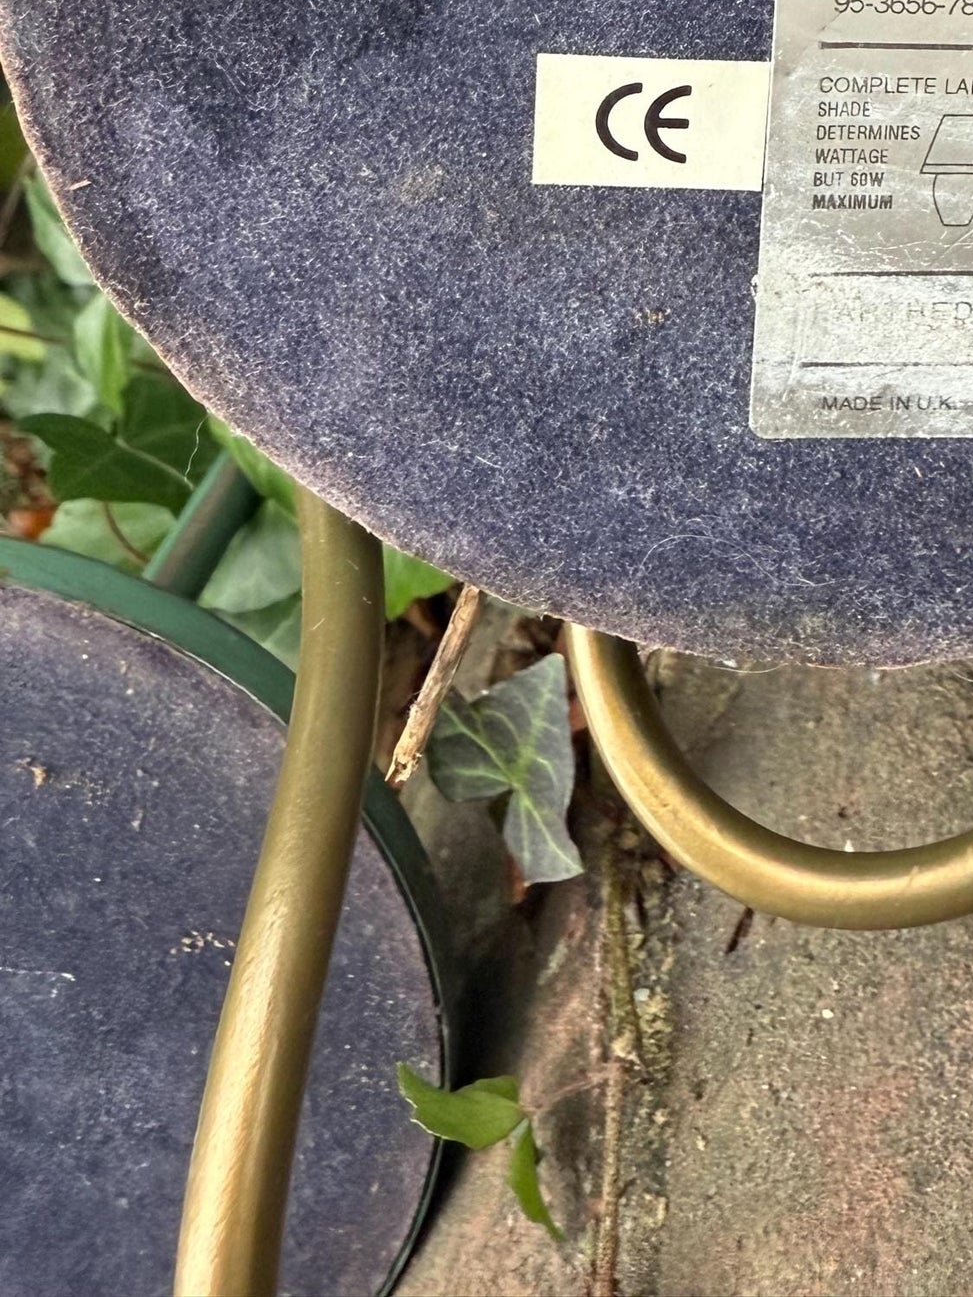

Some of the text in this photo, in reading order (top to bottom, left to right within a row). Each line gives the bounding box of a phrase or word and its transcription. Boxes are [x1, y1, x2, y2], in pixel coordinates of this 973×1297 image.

[819, 75, 938, 95] COMPLETE
[817, 100, 872, 118] SHADE
[595, 82, 693, 164] CE
[816, 123, 922, 142] DETERMINES
[815, 147, 889, 165] WATTAGE
[813, 171, 885, 188] BUT 60W
[812, 193, 894, 210] MAXIMUM
[821, 395, 883, 411] MADE
[889, 395, 911, 410] IN
